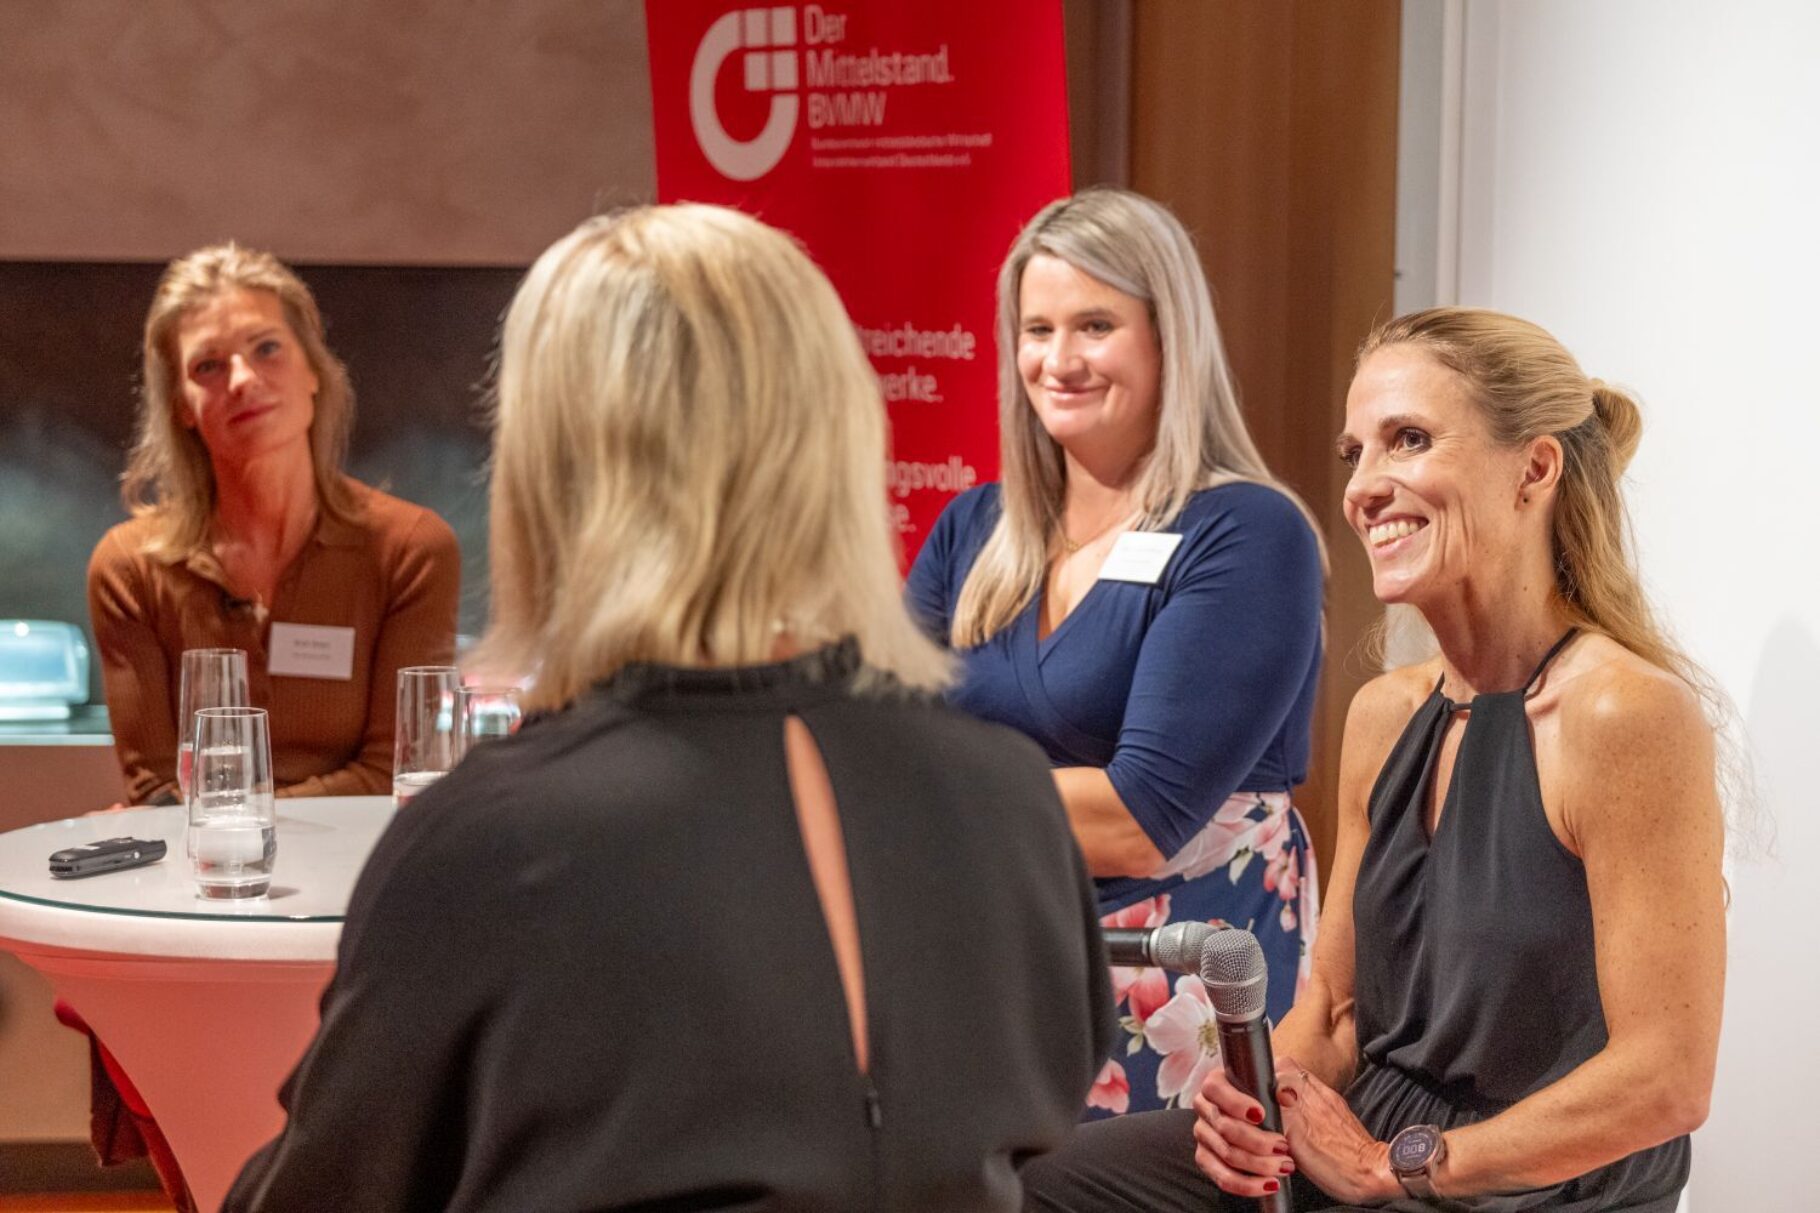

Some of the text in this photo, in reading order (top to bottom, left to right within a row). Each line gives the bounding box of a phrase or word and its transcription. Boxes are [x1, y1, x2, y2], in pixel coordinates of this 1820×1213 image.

[804, 4, 847, 45] Der
[806, 44, 955, 87] Mittelstand.
[808, 90, 887, 128] BVMW
